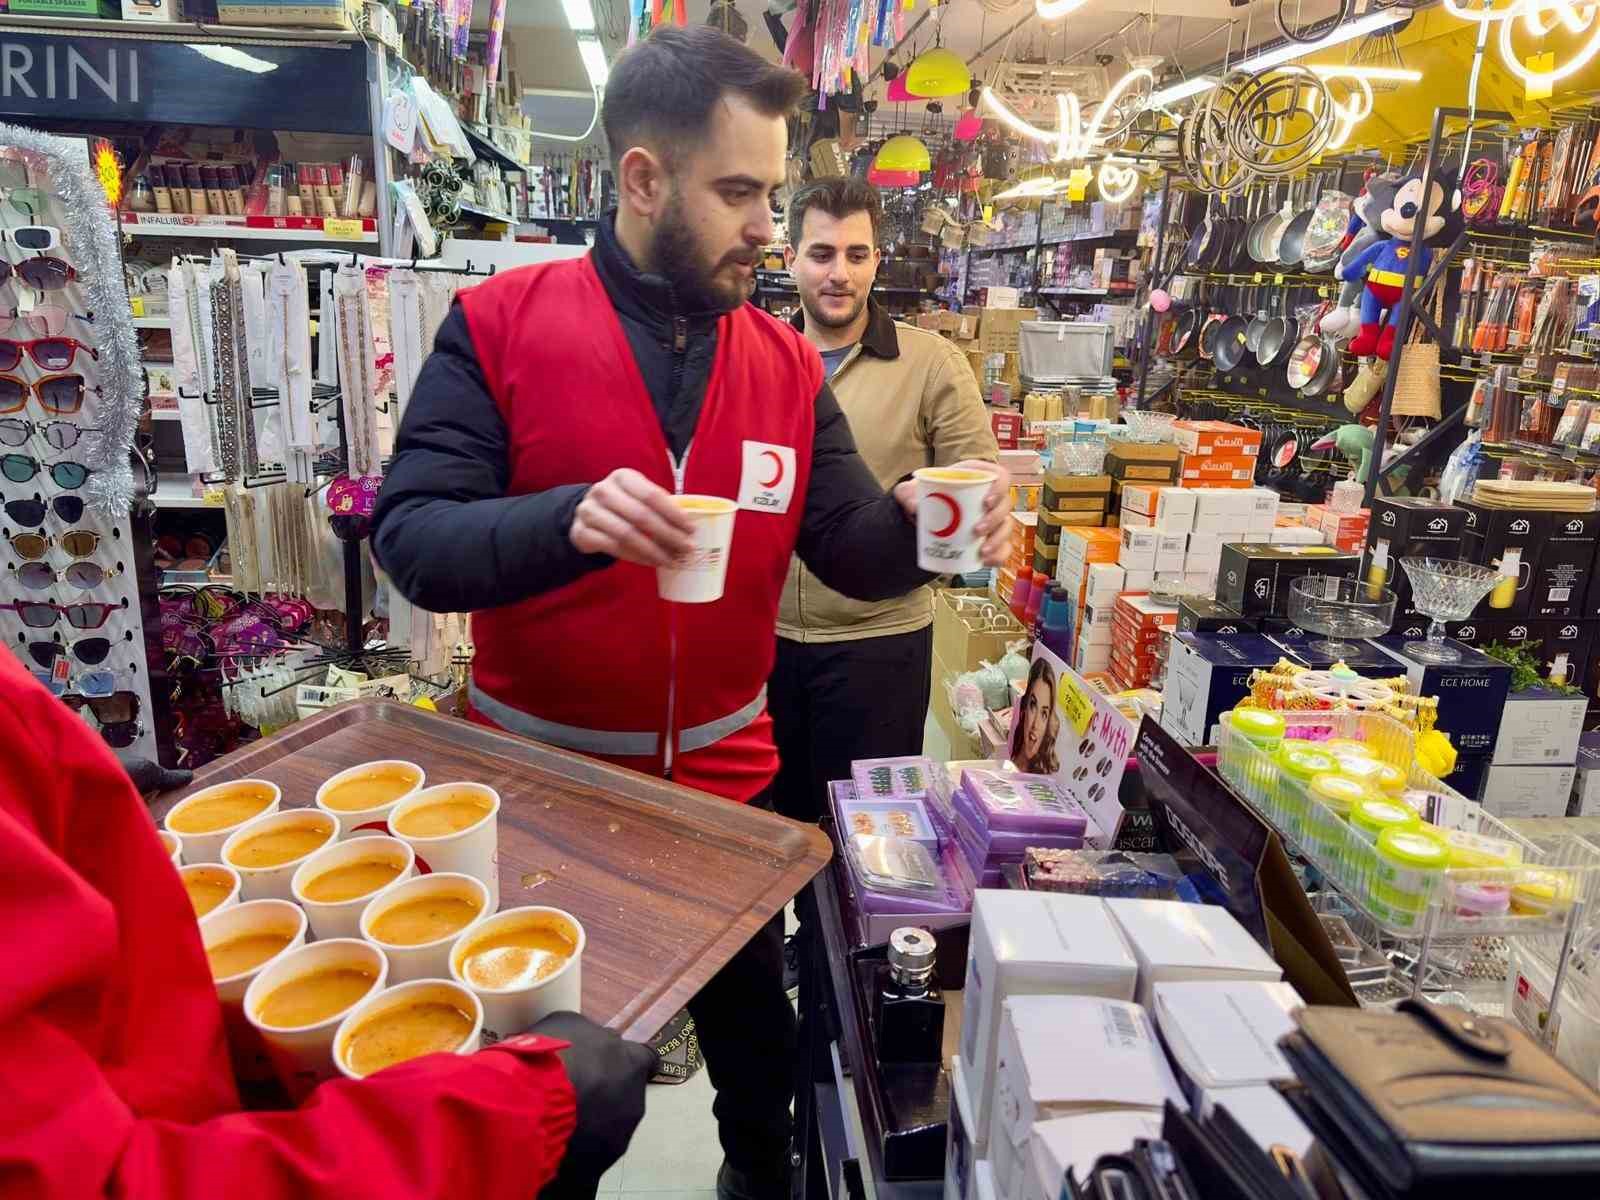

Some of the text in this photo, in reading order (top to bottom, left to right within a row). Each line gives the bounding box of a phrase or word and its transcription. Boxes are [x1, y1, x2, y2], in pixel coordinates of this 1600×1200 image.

[2, 43, 139, 103] RINI
[1460, 678, 1491, 688] HOME
[663, 1062, 688, 1077] BEAR
